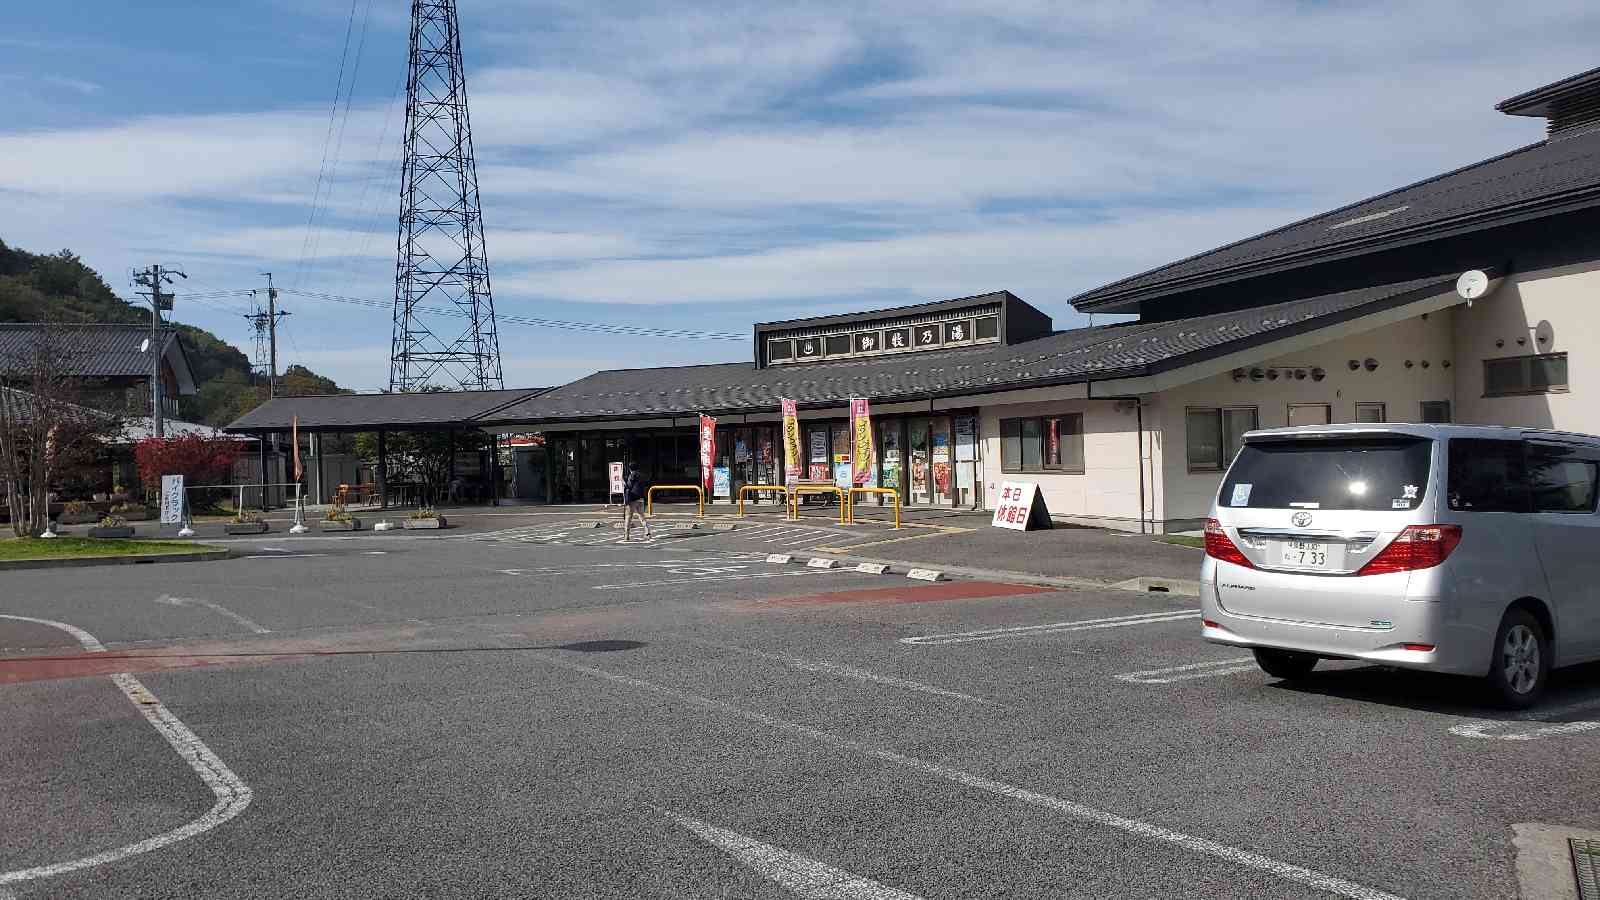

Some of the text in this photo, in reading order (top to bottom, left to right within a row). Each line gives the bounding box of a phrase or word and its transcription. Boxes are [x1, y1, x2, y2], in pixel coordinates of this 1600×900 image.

[861, 325, 965, 351] 御牧乃湯
[1002, 486, 1022, 502] 本日
[997, 504, 1028, 524] 休館日
